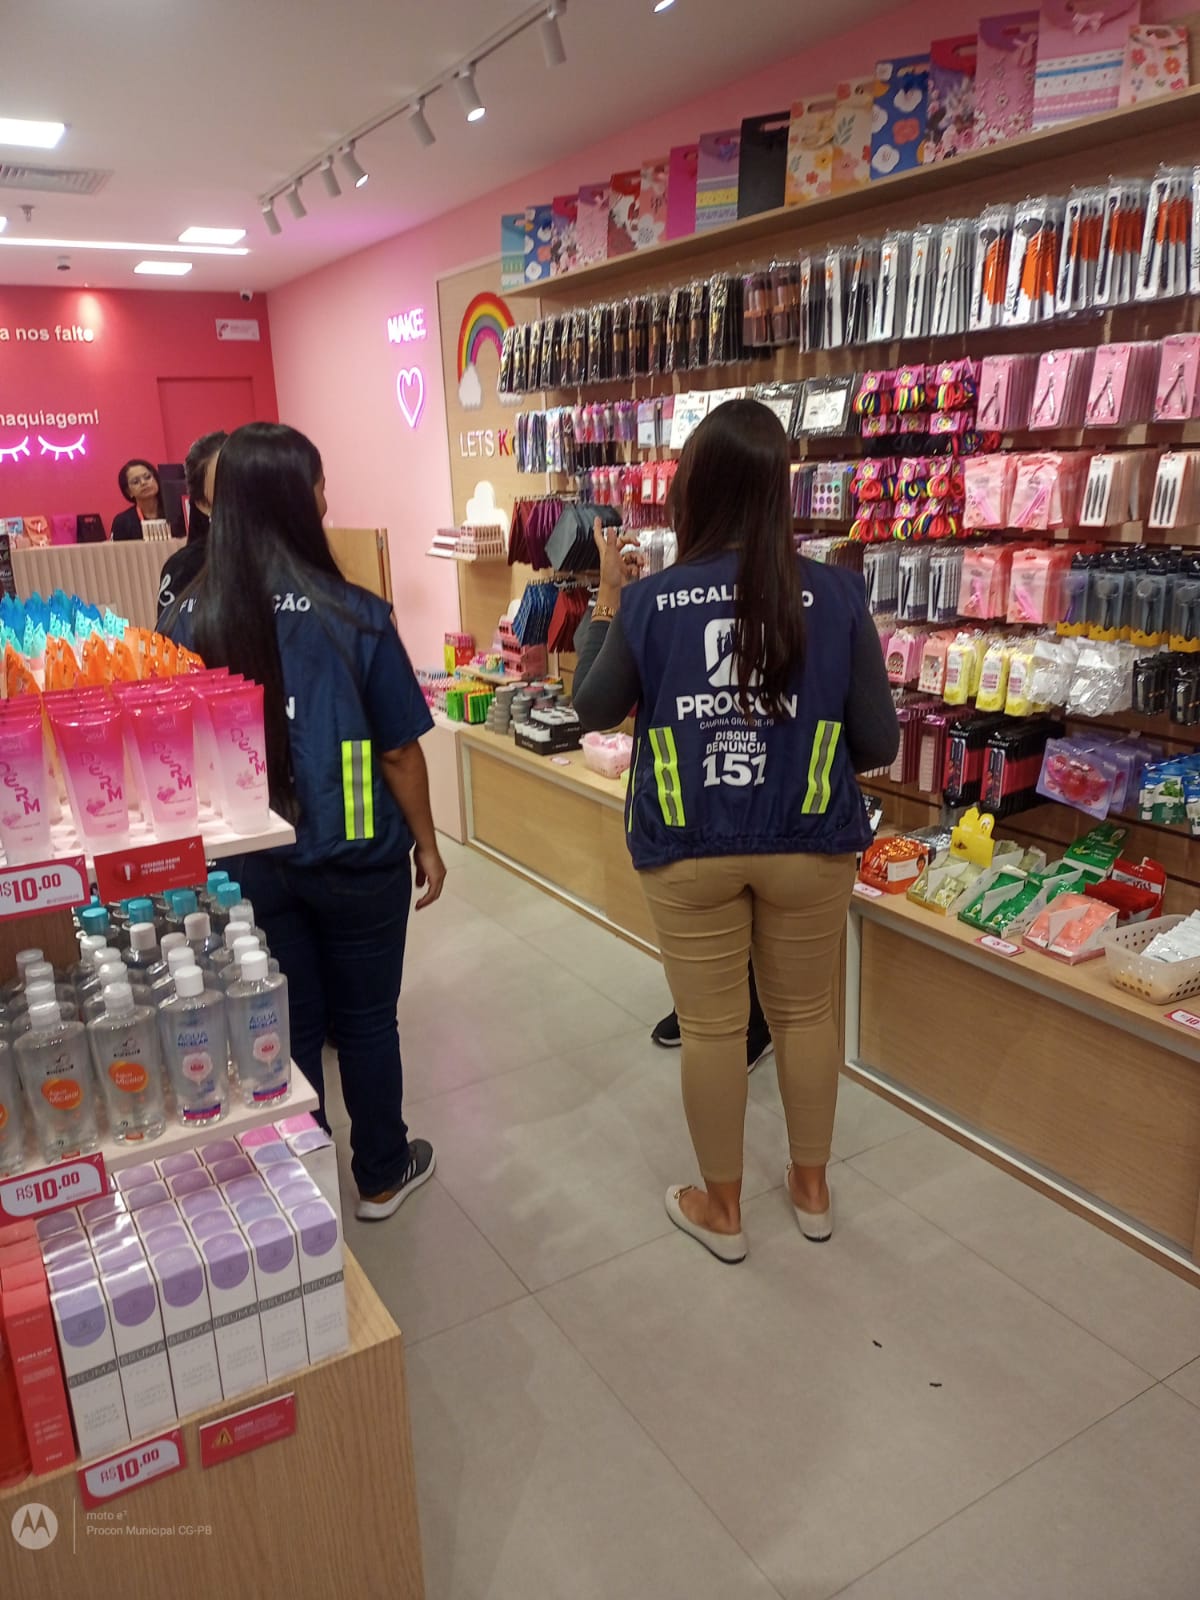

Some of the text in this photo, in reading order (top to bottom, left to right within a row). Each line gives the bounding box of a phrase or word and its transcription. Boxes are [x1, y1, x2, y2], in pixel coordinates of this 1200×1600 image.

[16, 327, 50, 341] nos
[387, 308, 427, 343] MAKE
[459, 430, 495, 457] LETS
[706, 739, 767, 754] DENÚNCIA
[715, 730, 757, 742] DISQUE
[702, 752, 767, 788] 151
